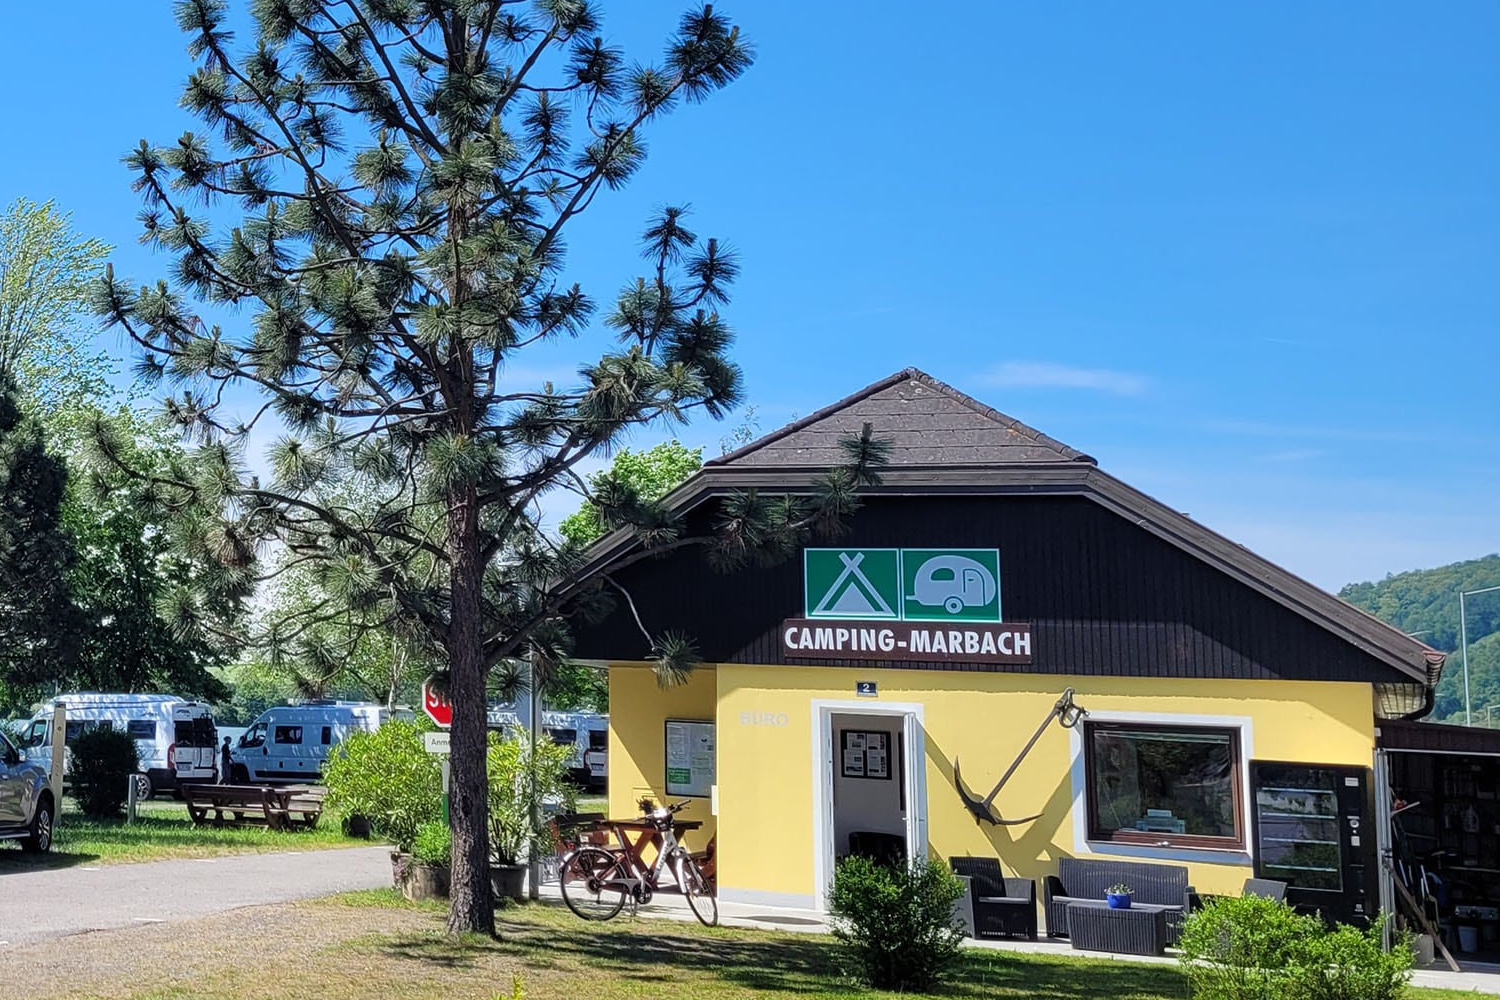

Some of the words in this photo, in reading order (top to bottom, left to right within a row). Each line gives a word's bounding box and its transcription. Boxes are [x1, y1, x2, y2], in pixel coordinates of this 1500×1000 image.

[784, 627, 1031, 656] CAMPING-MARBACH
[862, 683, 870, 693] 2
[739, 707, 789, 728] BÜRO
